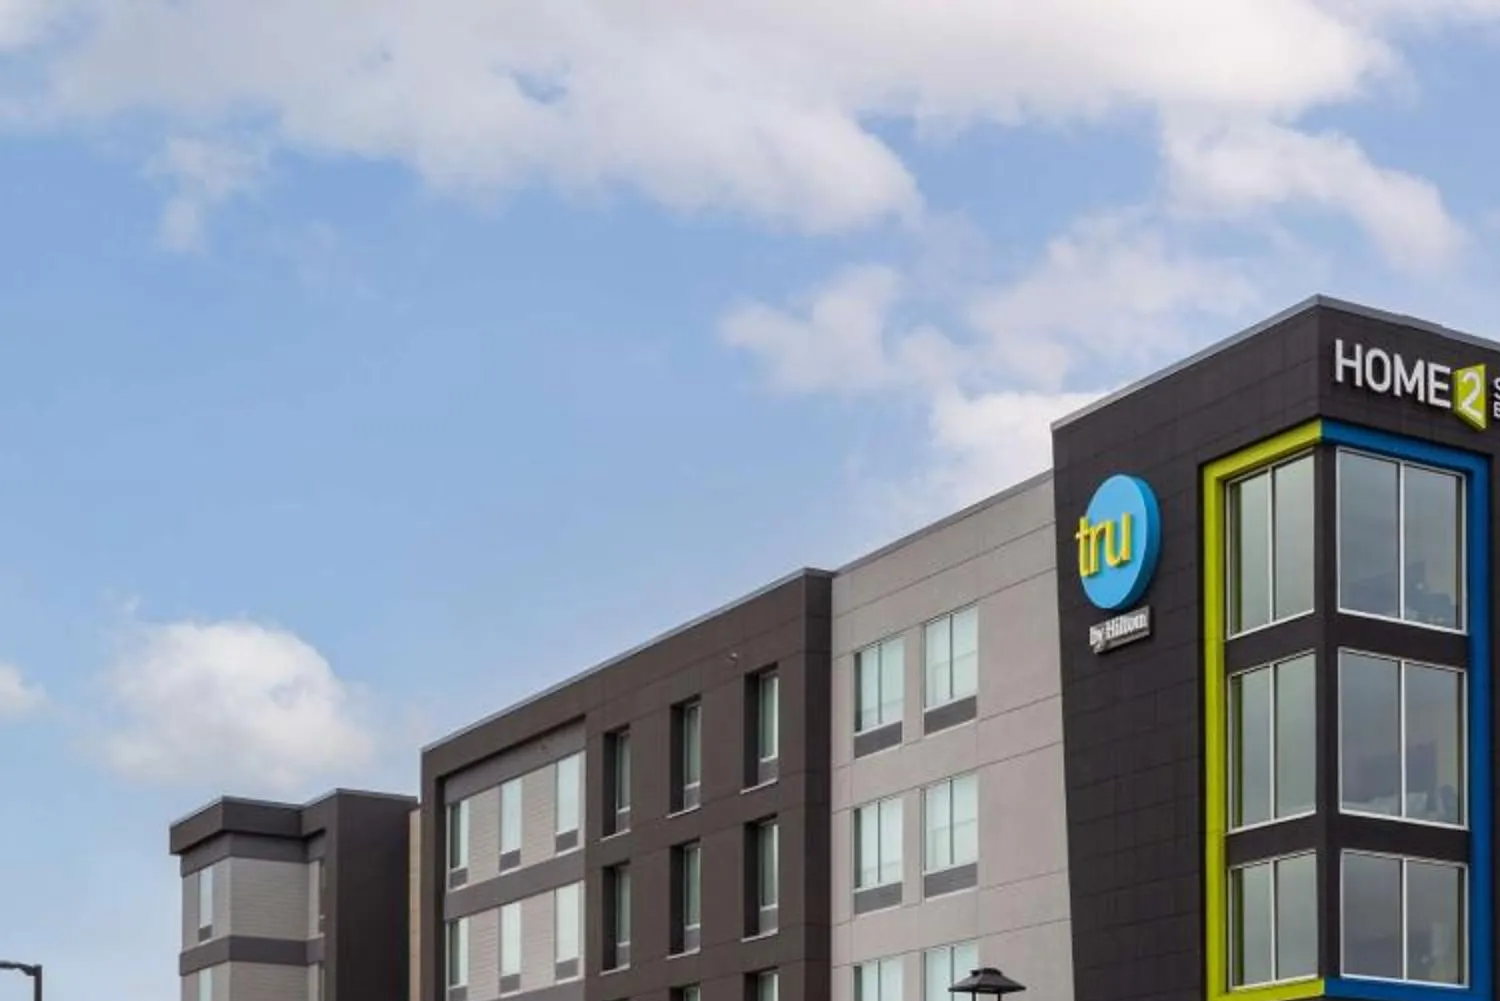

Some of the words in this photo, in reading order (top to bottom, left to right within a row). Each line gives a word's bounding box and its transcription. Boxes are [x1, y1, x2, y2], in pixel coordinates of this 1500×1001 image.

[1075, 512, 1132, 577] tru
[1089, 625, 1106, 654] by
[1106, 612, 1148, 641] Hilton
